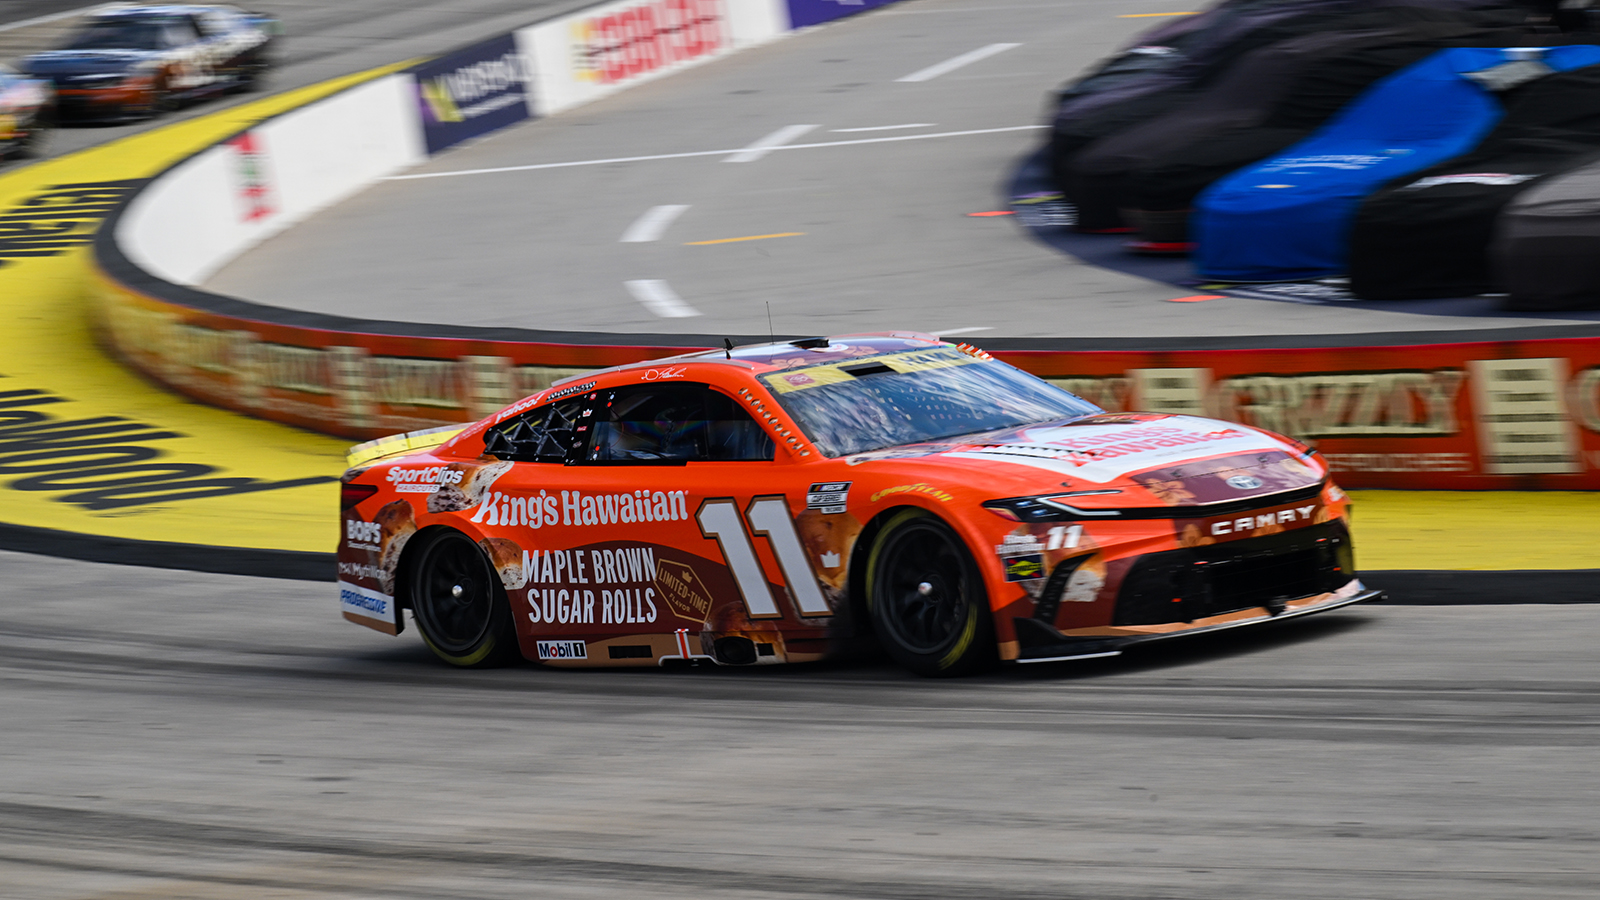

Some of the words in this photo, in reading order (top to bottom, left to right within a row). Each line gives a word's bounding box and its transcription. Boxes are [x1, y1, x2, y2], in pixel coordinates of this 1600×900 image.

[495, 393, 545, 424] yahoo!
[386, 466, 464, 487] SportClips
[470, 489, 559, 529] King's
[561, 489, 688, 526] Hawaiian
[1211, 505, 1316, 535] CAMRY
[347, 520, 382, 544] BOB'S
[1047, 525, 1083, 550] 11
[522, 550, 588, 583] MAPLE
[591, 548, 657, 584] BROWN
[694, 493, 834, 620] 11
[527, 588, 595, 624] SUGAR
[602, 588, 657, 624] ROLLS
[658, 567, 708, 615] LIMITED-TIME
[669, 593, 691, 613] FLAVOR
[538, 643, 572, 658] Mobil
[575, 643, 585, 657] 1
